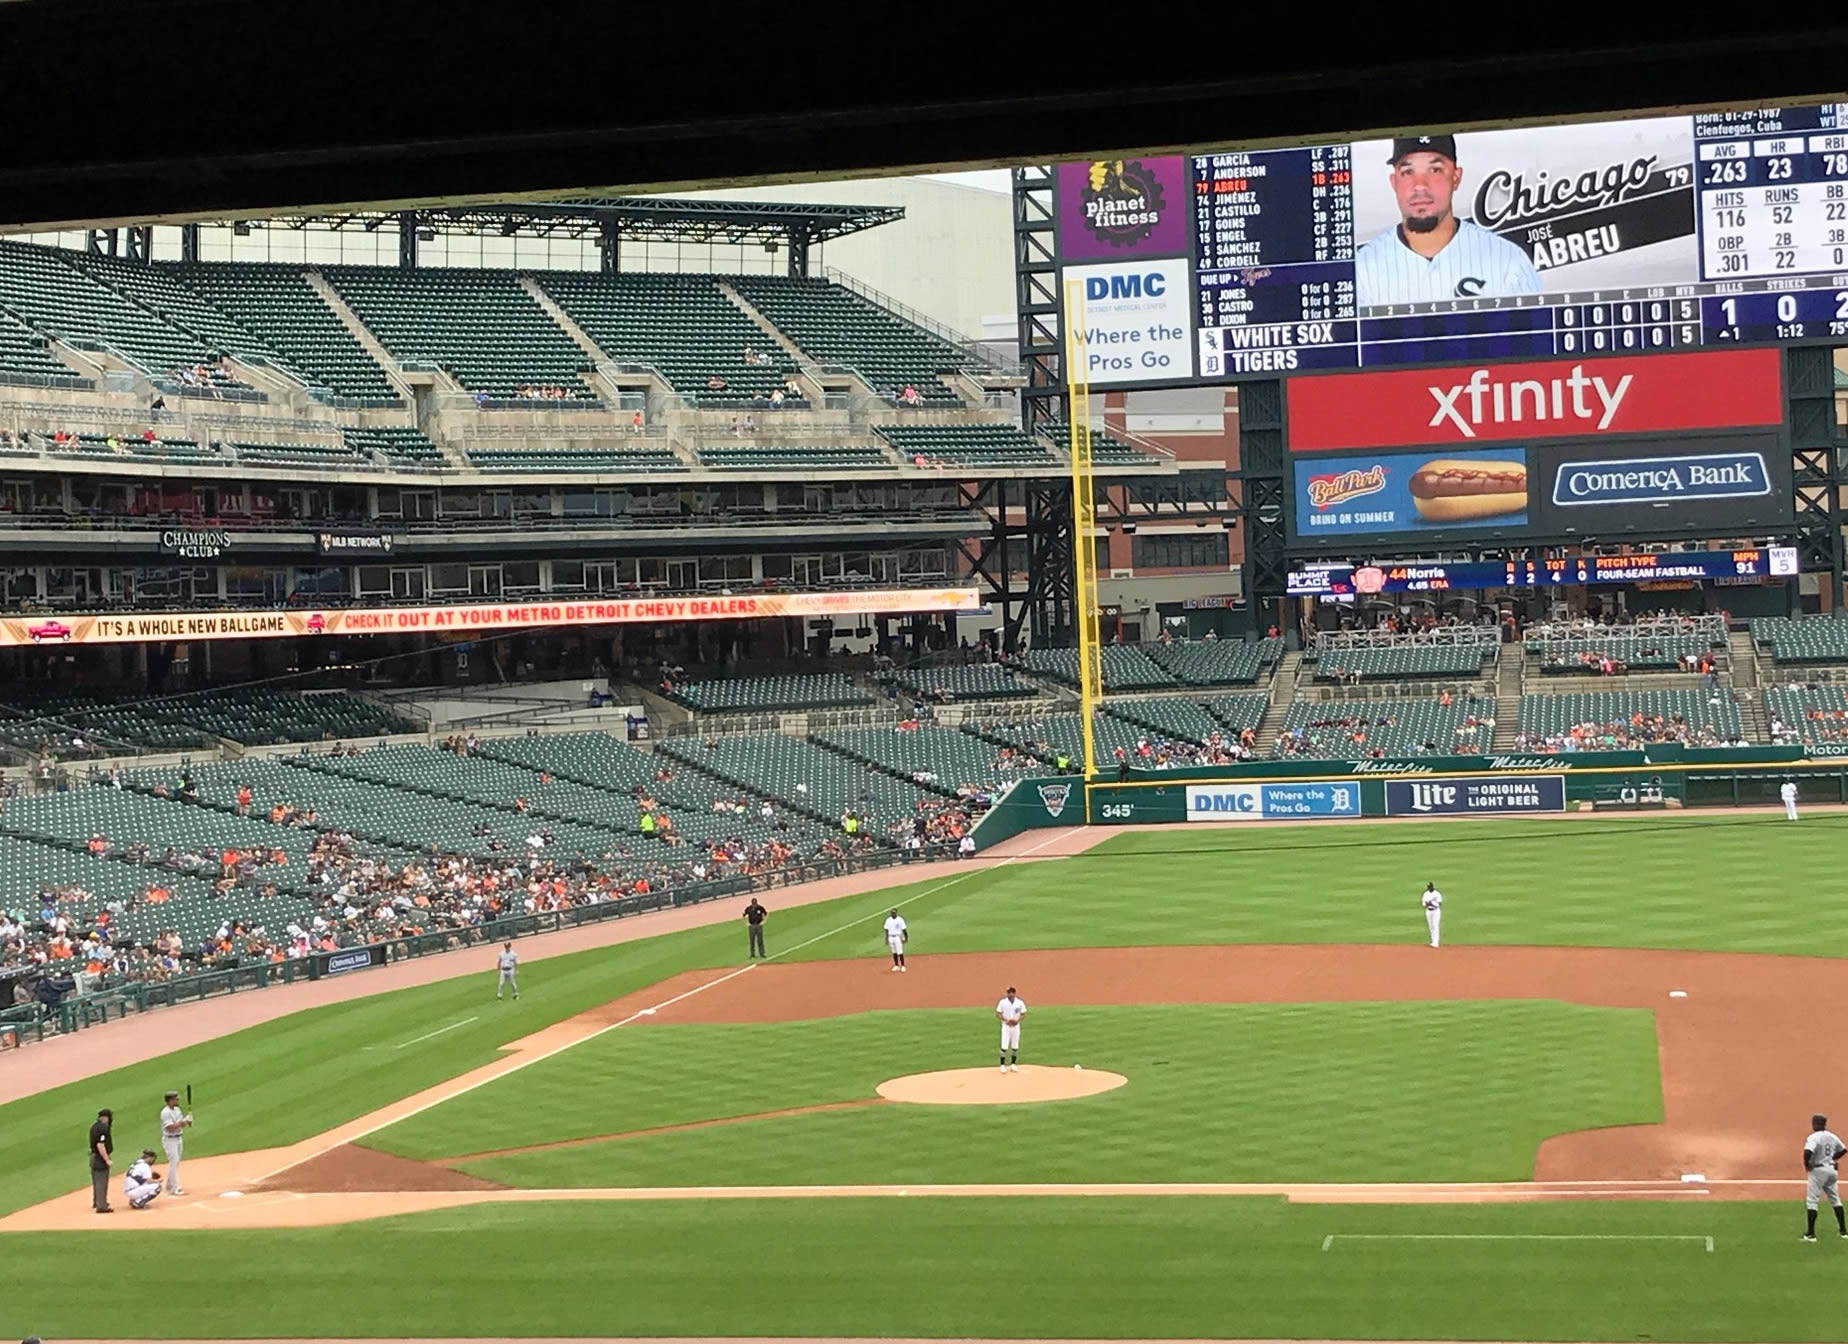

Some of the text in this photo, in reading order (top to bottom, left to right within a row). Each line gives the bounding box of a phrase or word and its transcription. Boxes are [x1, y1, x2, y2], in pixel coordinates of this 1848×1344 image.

[1696, 121, 1782, 136] Cienfuegos, Cuba
[1715, 145, 1736, 157] AVG
[1771, 142, 1786, 153] HR
[1826, 137, 1844, 149] RBI
[1196, 158, 1207, 169] 28
[1312, 149, 1322, 159] LF
[1824, 154, 1847, 175] 78
[1201, 160, 1348, 180] 7 ANDERSON SS .311
[1705, 161, 1746, 184] .263
[1768, 158, 1792, 179] 23
[1197, 174, 1325, 193] 79 ABREU 1B
[1665, 168, 1689, 188] 79
[1197, 185, 1350, 206] 74 JIMÉNEZ DH .236
[1474, 154, 1657, 227] Chicago
[1716, 192, 1744, 206] HITS
[1765, 188, 1798, 202] RUNS
[1827, 186, 1843, 198] BB
[1086, 196, 1145, 217] planet
[1198, 198, 1350, 218] 21 CASTILLO C .176
[1773, 206, 1792, 224] 52
[1826, 203, 1845, 220] 22
[1095, 211, 1158, 227] fitness
[1199, 211, 1350, 231] 17 GOINS 3B .291
[1716, 210, 1745, 228] 116
[1199, 223, 1350, 243] 15 ENGEL CF .227
[1527, 223, 1552, 243] JOSÉ
[1776, 233, 1792, 246] 2B
[1829, 229, 1844, 242] 3B
[1204, 236, 1351, 256] 5 SÁNCHEZ 2B .253
[1533, 224, 1620, 270] ABREU
[1719, 236, 1743, 249] OBP
[1200, 249, 1352, 268] 49 CORDELL RF .229
[1717, 254, 1748, 273] .301
[1776, 251, 1795, 268] 22
[1834, 248, 1843, 265] 0
[1087, 273, 1165, 300] DMC
[1201, 275, 1217, 285] DUE
[1219, 274, 1231, 284] UP
[1201, 281, 1353, 301] 21 JONES .236
[1202, 301, 1253, 313] 30 CASTRO
[1722, 299, 1735, 325] 1
[1778, 295, 1796, 322] 0
[1203, 307, 1354, 326] 12 DIXON .265
[1231, 301, 1691, 348] WHITE SOX 0 0 0 0 5
[1074, 324, 1182, 345] Where the
[1733, 327, 1739, 340] 1
[1776, 324, 1803, 338] 1:12
[1232, 326, 1692, 372] TIGERS 0 0 0 0 5
[1090, 351, 1170, 371] Pros Go
[1428, 365, 1633, 437] xfinity
[1688, 463, 1752, 486] Bank
[1311, 468, 1382, 503] Ball Park
[1339, 513, 1351, 524] ON
[1354, 511, 1394, 524] SUMMER
[164, 531, 231, 547] CHAMPIONS
[332, 536, 381, 548] MLB NETWORK
[186, 546, 213, 557] CLUB
[1733, 552, 1759, 562] MPH
[1772, 549, 1794, 559] MVR
[1596, 556, 1657, 568] PITCH TYPE
[1736, 562, 1755, 574] 91
[1779, 560, 1790, 572] 5
[1389, 567, 1445, 580] 44 Norris
[1506, 574, 1515, 584] 2
[1526, 573, 1534, 583] 2
[1552, 571, 1560, 582] 4
[1578, 570, 1586, 581] 0
[1596, 566, 1706, 580] FOUR-SEAM FASTBALL
[1288, 578, 1330, 587] PLACE
[345, 600, 757, 629] CHECK IT OUT AT YOUR METRO DETROIT CHEVY DEALERS
[97, 617, 284, 637] IT'S A WHOLE NEW BALLGAME
[1804, 745, 1848, 755] Motor
[1411, 784, 1456, 811] Lite
[1481, 784, 1539, 794] ORIGINAL
[1194, 789, 1324, 813] DMC Where the
[1269, 803, 1310, 813] Pros Go
[1468, 796, 1539, 807] LIGHT BEER
[1825, 1144, 1831, 1156] 8
